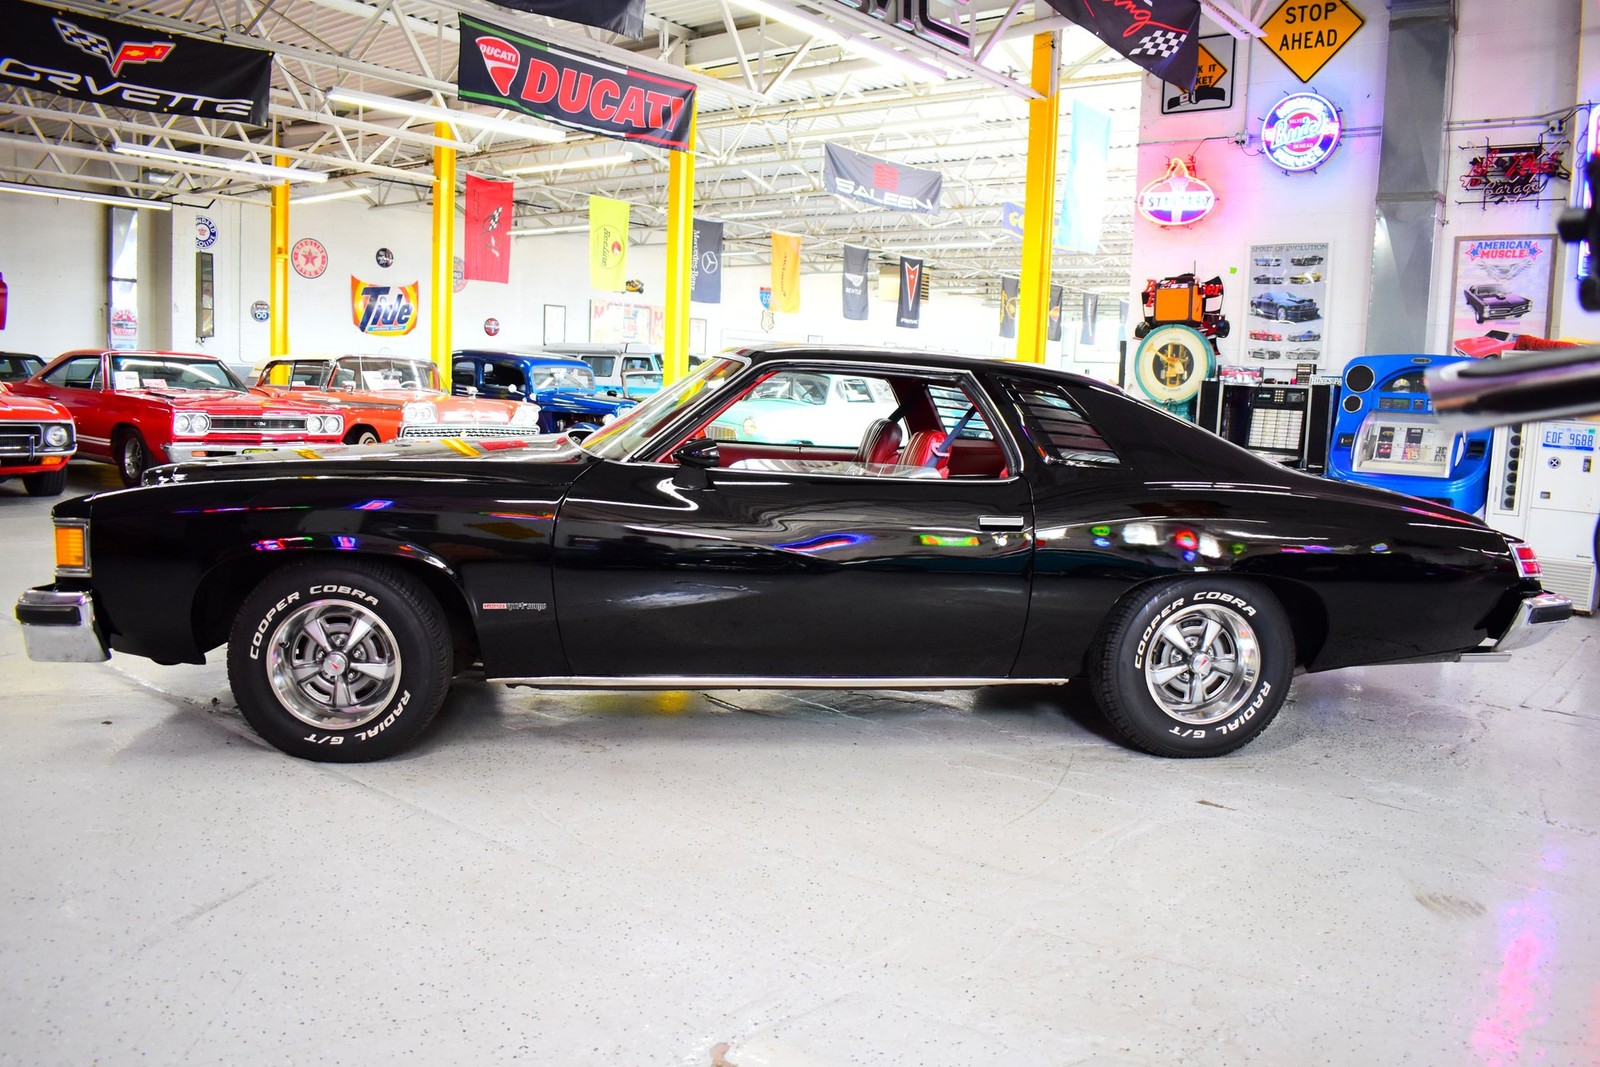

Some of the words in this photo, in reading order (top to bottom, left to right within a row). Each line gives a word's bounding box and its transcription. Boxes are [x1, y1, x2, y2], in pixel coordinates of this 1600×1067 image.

[1285, 2, 1337, 24] STOP
[1279, 29, 1338, 51] AHEAD
[479, 43, 516, 63] DUCATI
[0, 57, 254, 117] ORVETTE
[1196, 76, 1213, 85] KET
[521, 58, 685, 132] DUCATI
[835, 177, 934, 210] SALEEN
[1286, 244, 1328, 252] EVOLUTION
[1476, 240, 1532, 250] AMERICAN
[1480, 249, 1527, 259] MUSCLE
[691, 229, 701, 291] Mercedes-Benz
[359, 286, 413, 332] Tide
[1545, 431, 1563, 444] EDF
[1569, 433, 1594, 447] 9688
[250, 591, 300, 660] COOPER
[309, 584, 379, 606] COBRA
[1134, 597, 1184, 670] COOPER
[1193, 591, 1257, 617] COBRA
[355, 690, 411, 741] RADIAL
[1215, 681, 1271, 735] RADIAL
[304, 733, 344, 745] G/T
[1169, 726, 1206, 739] G/T
